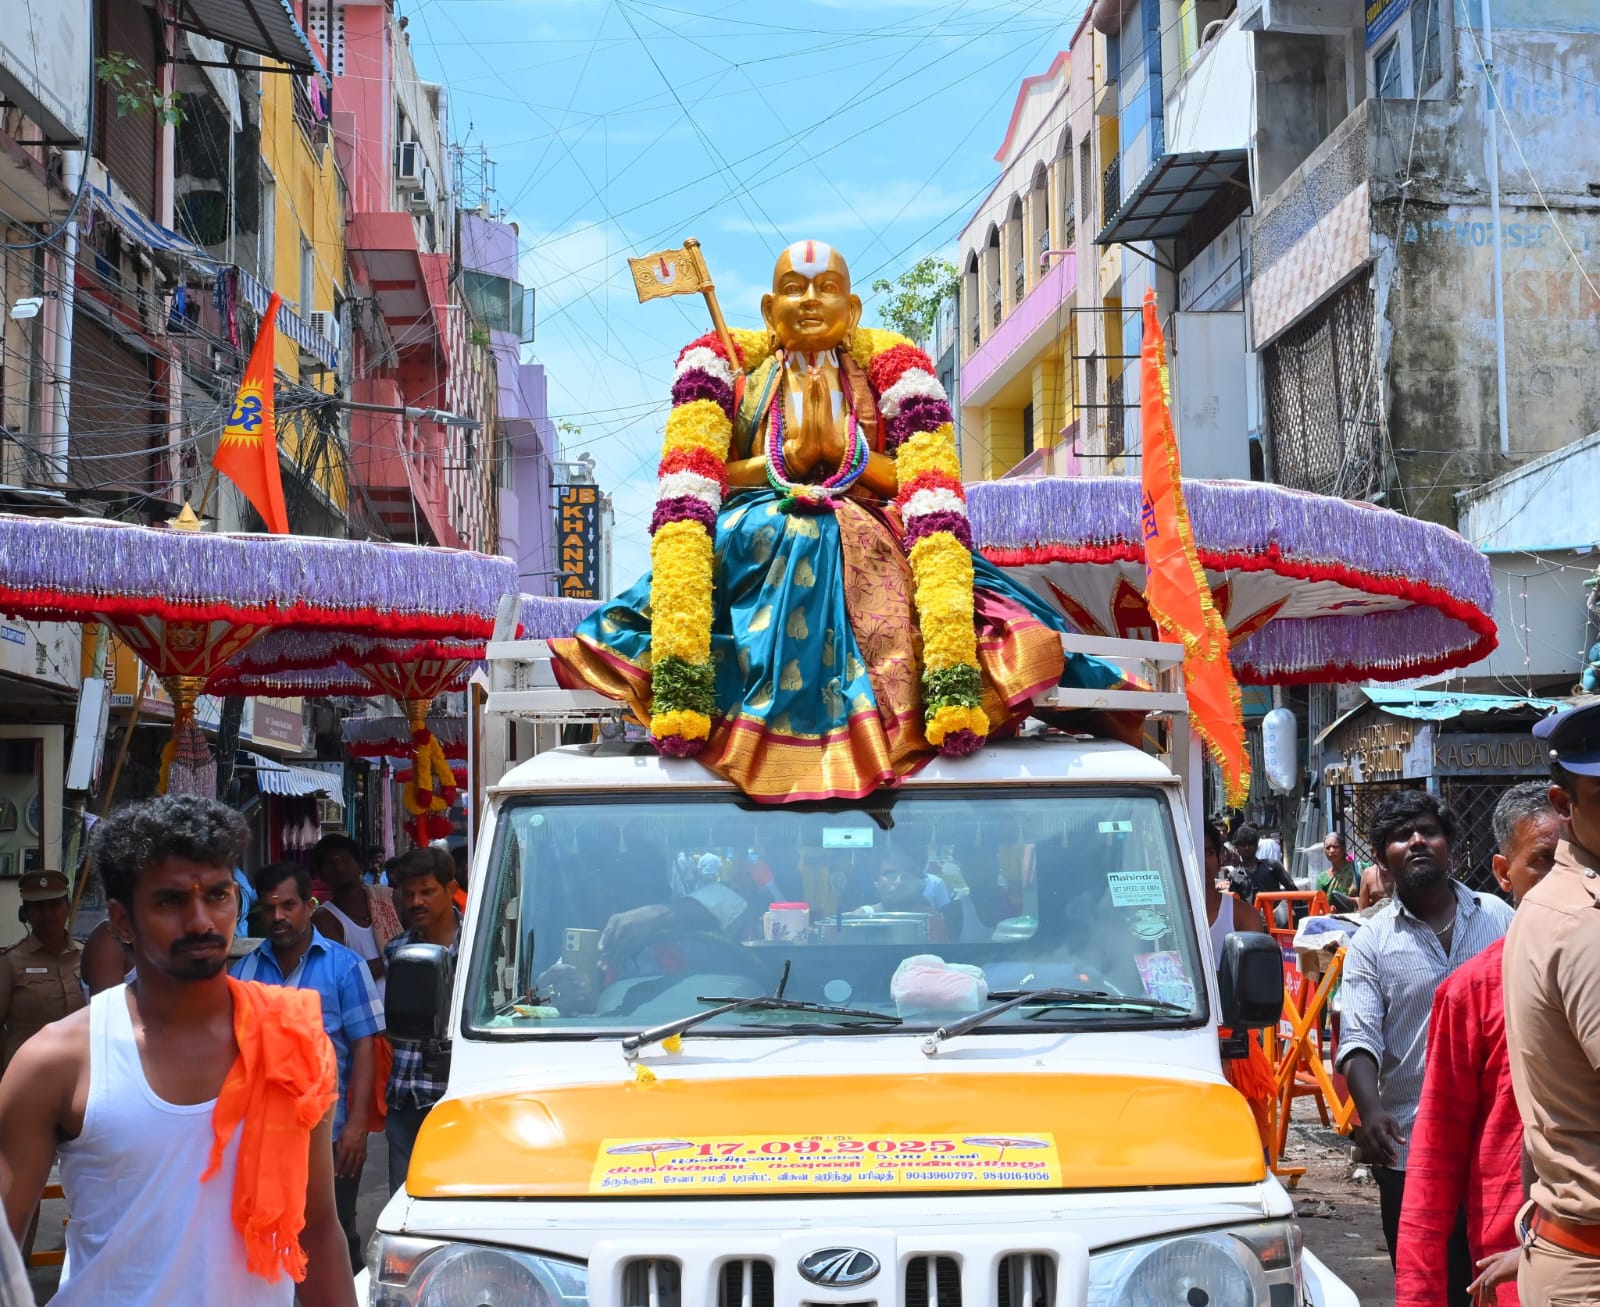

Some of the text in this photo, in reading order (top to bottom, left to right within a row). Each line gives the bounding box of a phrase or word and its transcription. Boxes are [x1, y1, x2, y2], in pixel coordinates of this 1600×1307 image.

[562, 488, 595, 504] JB
[562, 505, 585, 588] KHANNA
[565, 590, 592, 598] FINE
[1433, 742, 1549, 767] KAGOVINDA
[695, 1140, 956, 1156] 17.09.2025
[983, 1171, 1049, 1181] 9840164056
